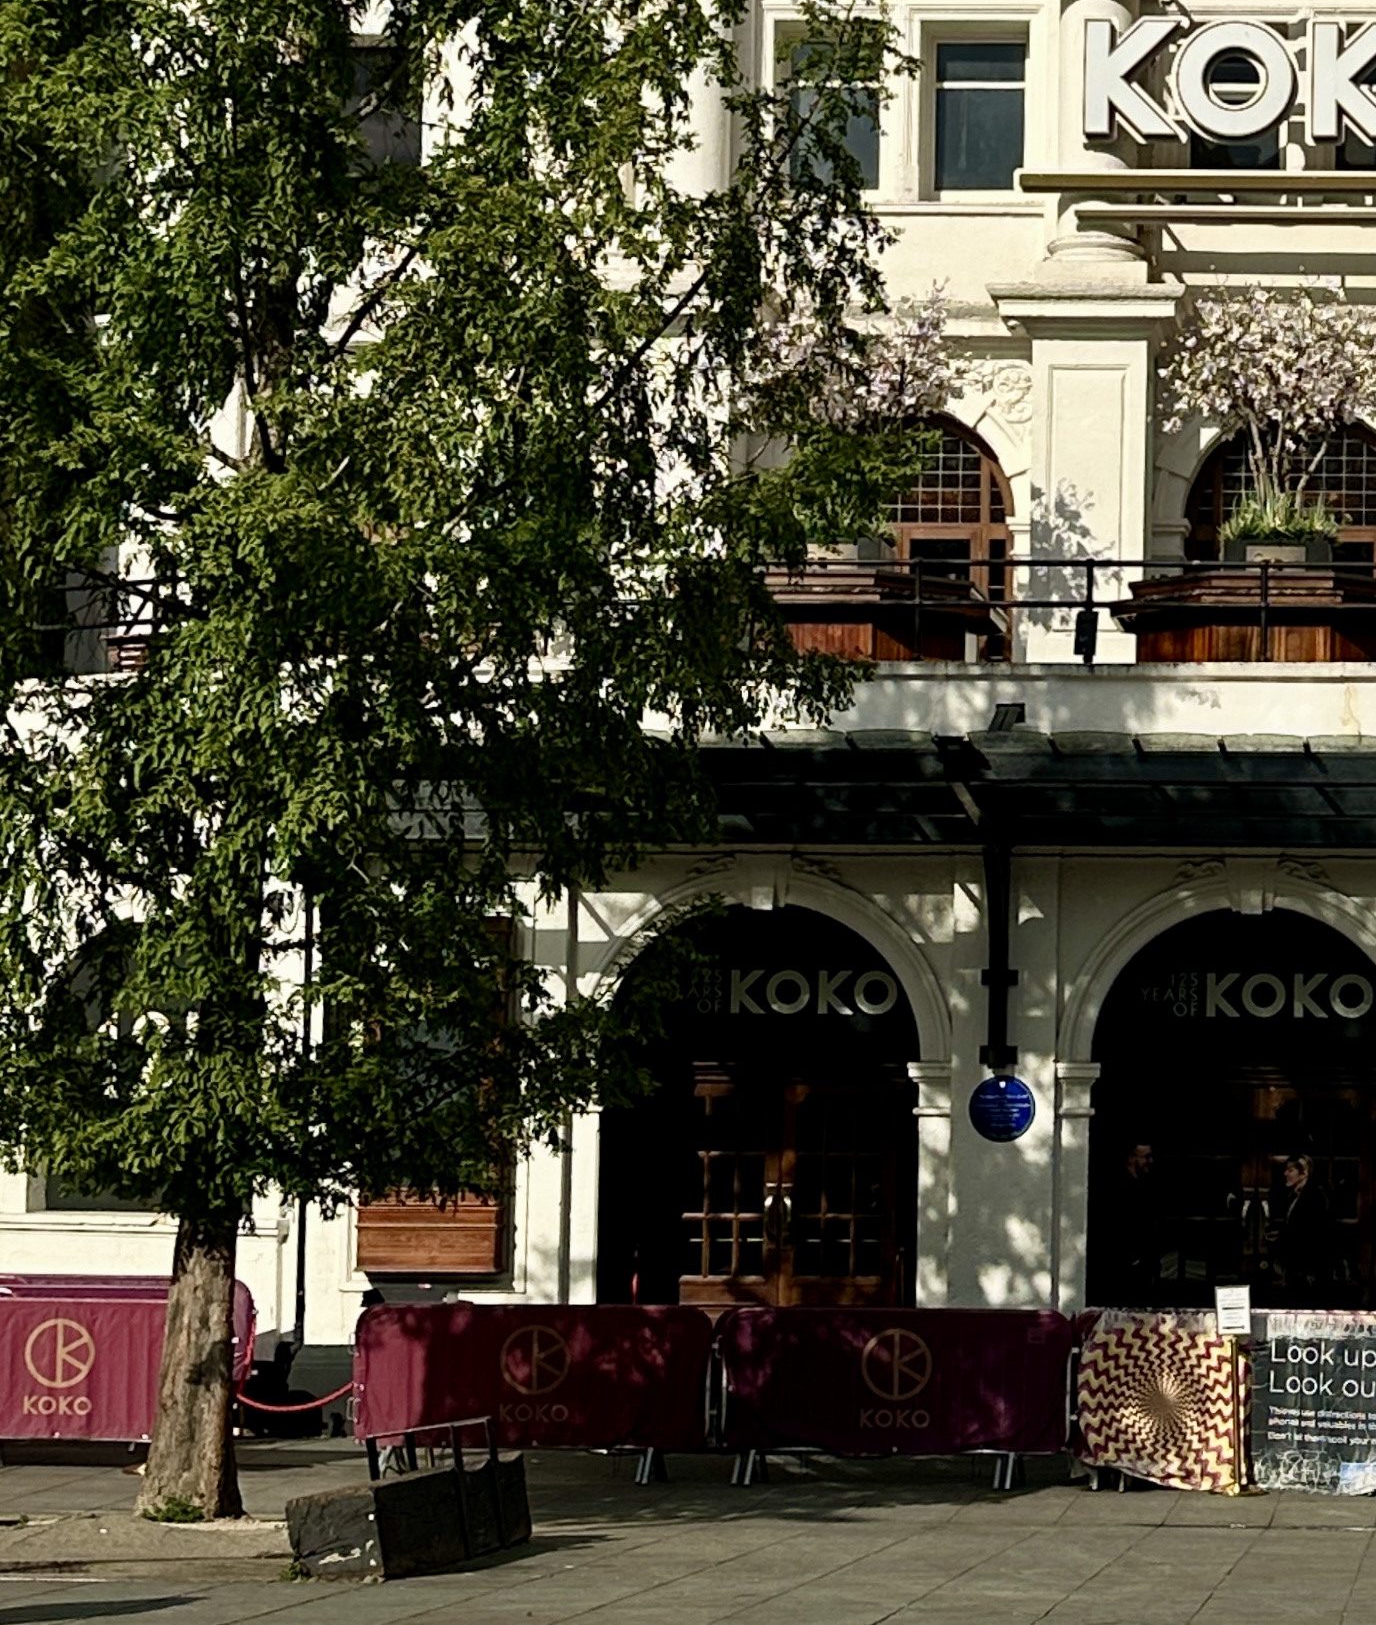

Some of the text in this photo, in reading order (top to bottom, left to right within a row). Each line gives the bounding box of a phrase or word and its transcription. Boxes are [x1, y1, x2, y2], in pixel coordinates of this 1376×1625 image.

[1170, 972, 1199, 987] 125
[729, 969, 898, 1016] KOKO
[1139, 986, 1199, 1002] YEARS
[1205, 972, 1375, 1019] KOKO
[696, 998, 722, 1014] OF
[1172, 1002, 1199, 1017] OF
[1271, 1340, 1334, 1366] Look
[1269, 1370, 1333, 1396] Look
[22, 1395, 93, 1416] KOKO
[499, 1403, 570, 1423] KOKO
[859, 1408, 931, 1429] KOKO
